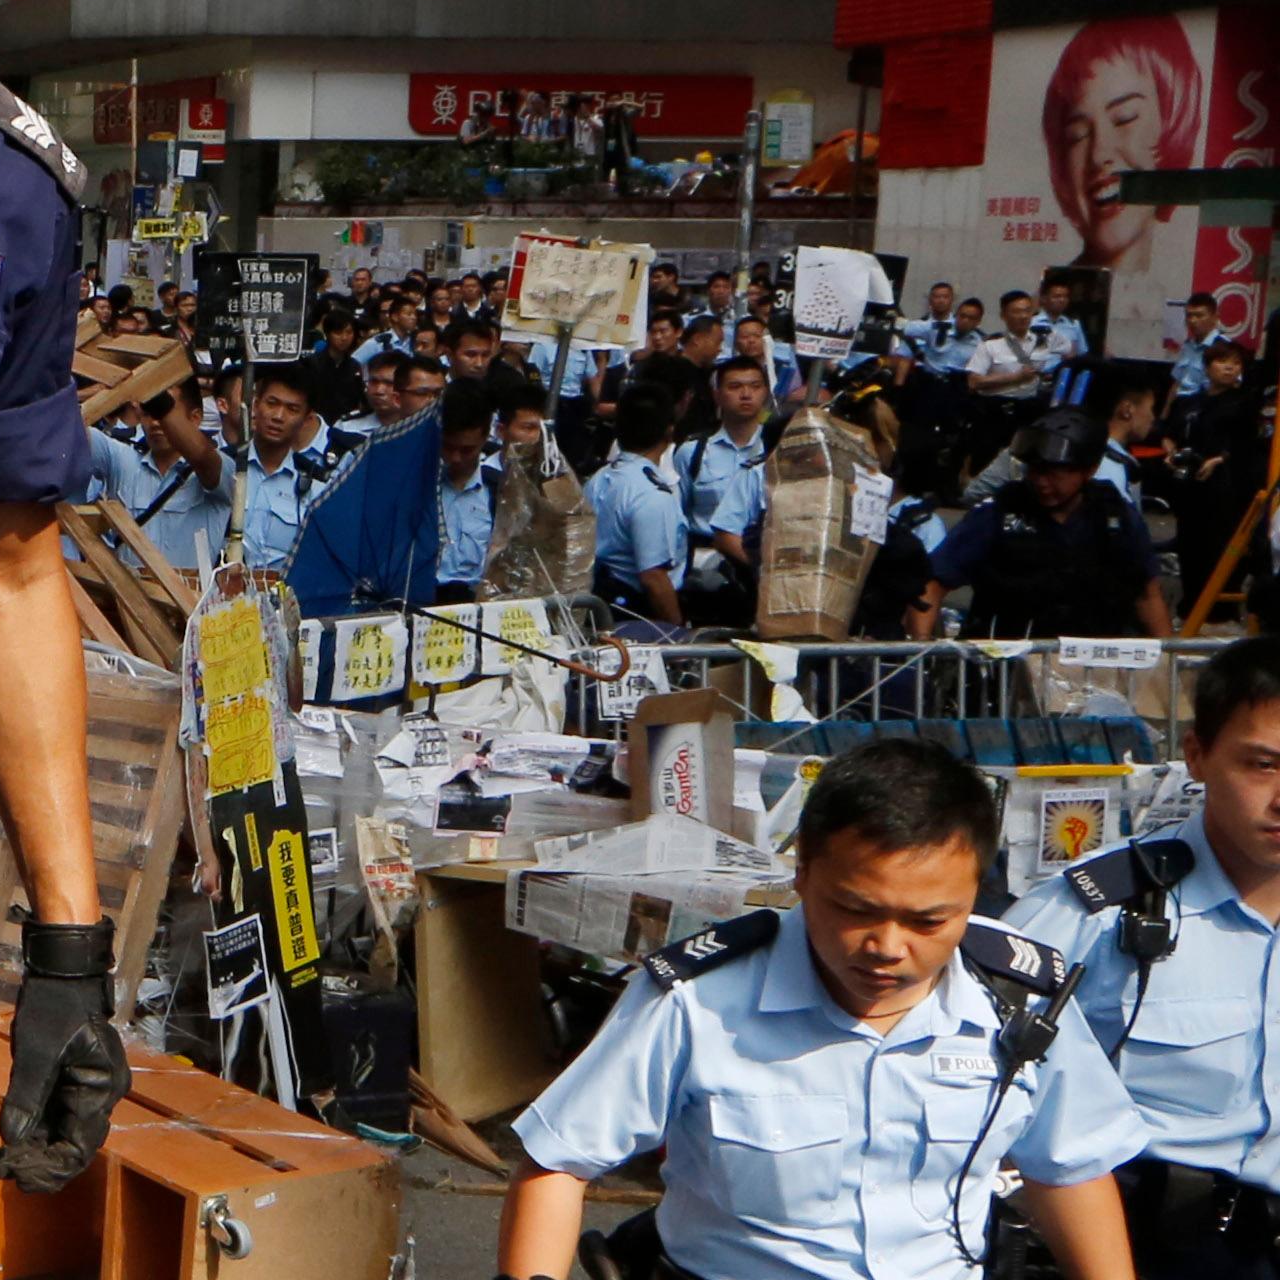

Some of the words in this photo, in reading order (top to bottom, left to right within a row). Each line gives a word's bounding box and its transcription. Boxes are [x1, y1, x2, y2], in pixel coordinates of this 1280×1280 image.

[278, 840, 308, 962] 我要真普選
[1072, 870, 1106, 903] 10837
